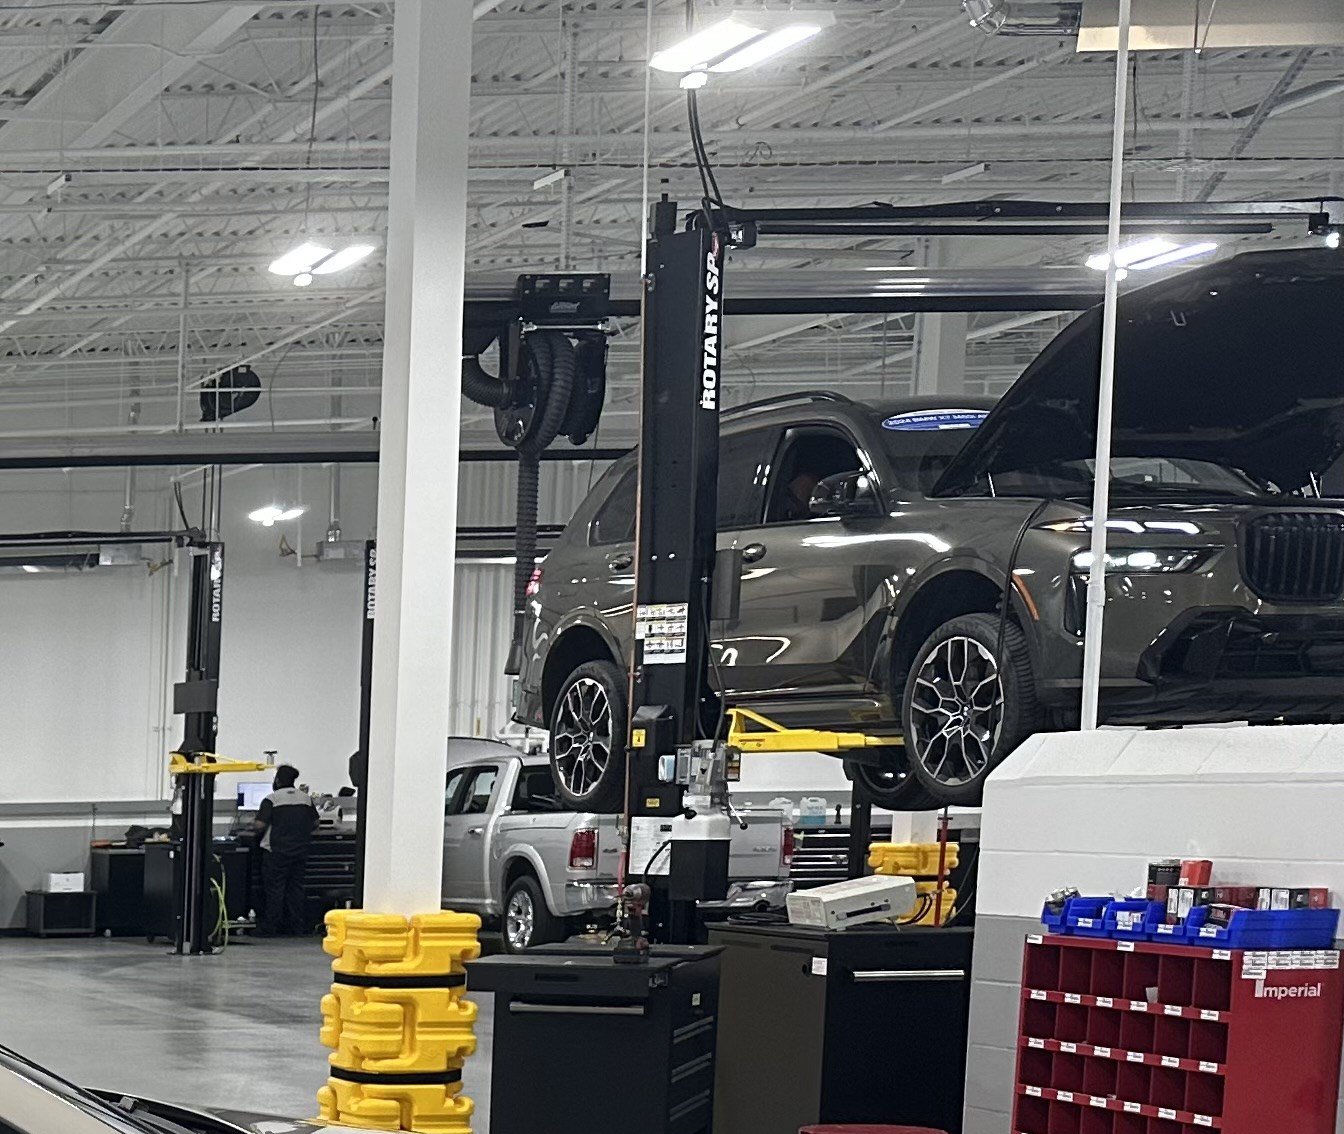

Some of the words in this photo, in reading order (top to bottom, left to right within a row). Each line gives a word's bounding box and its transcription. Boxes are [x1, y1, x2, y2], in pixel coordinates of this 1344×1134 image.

[706, 252, 719, 295] SP
[702, 295, 718, 410] ROTARY
[1254, 979, 1322, 1000] Imperial
